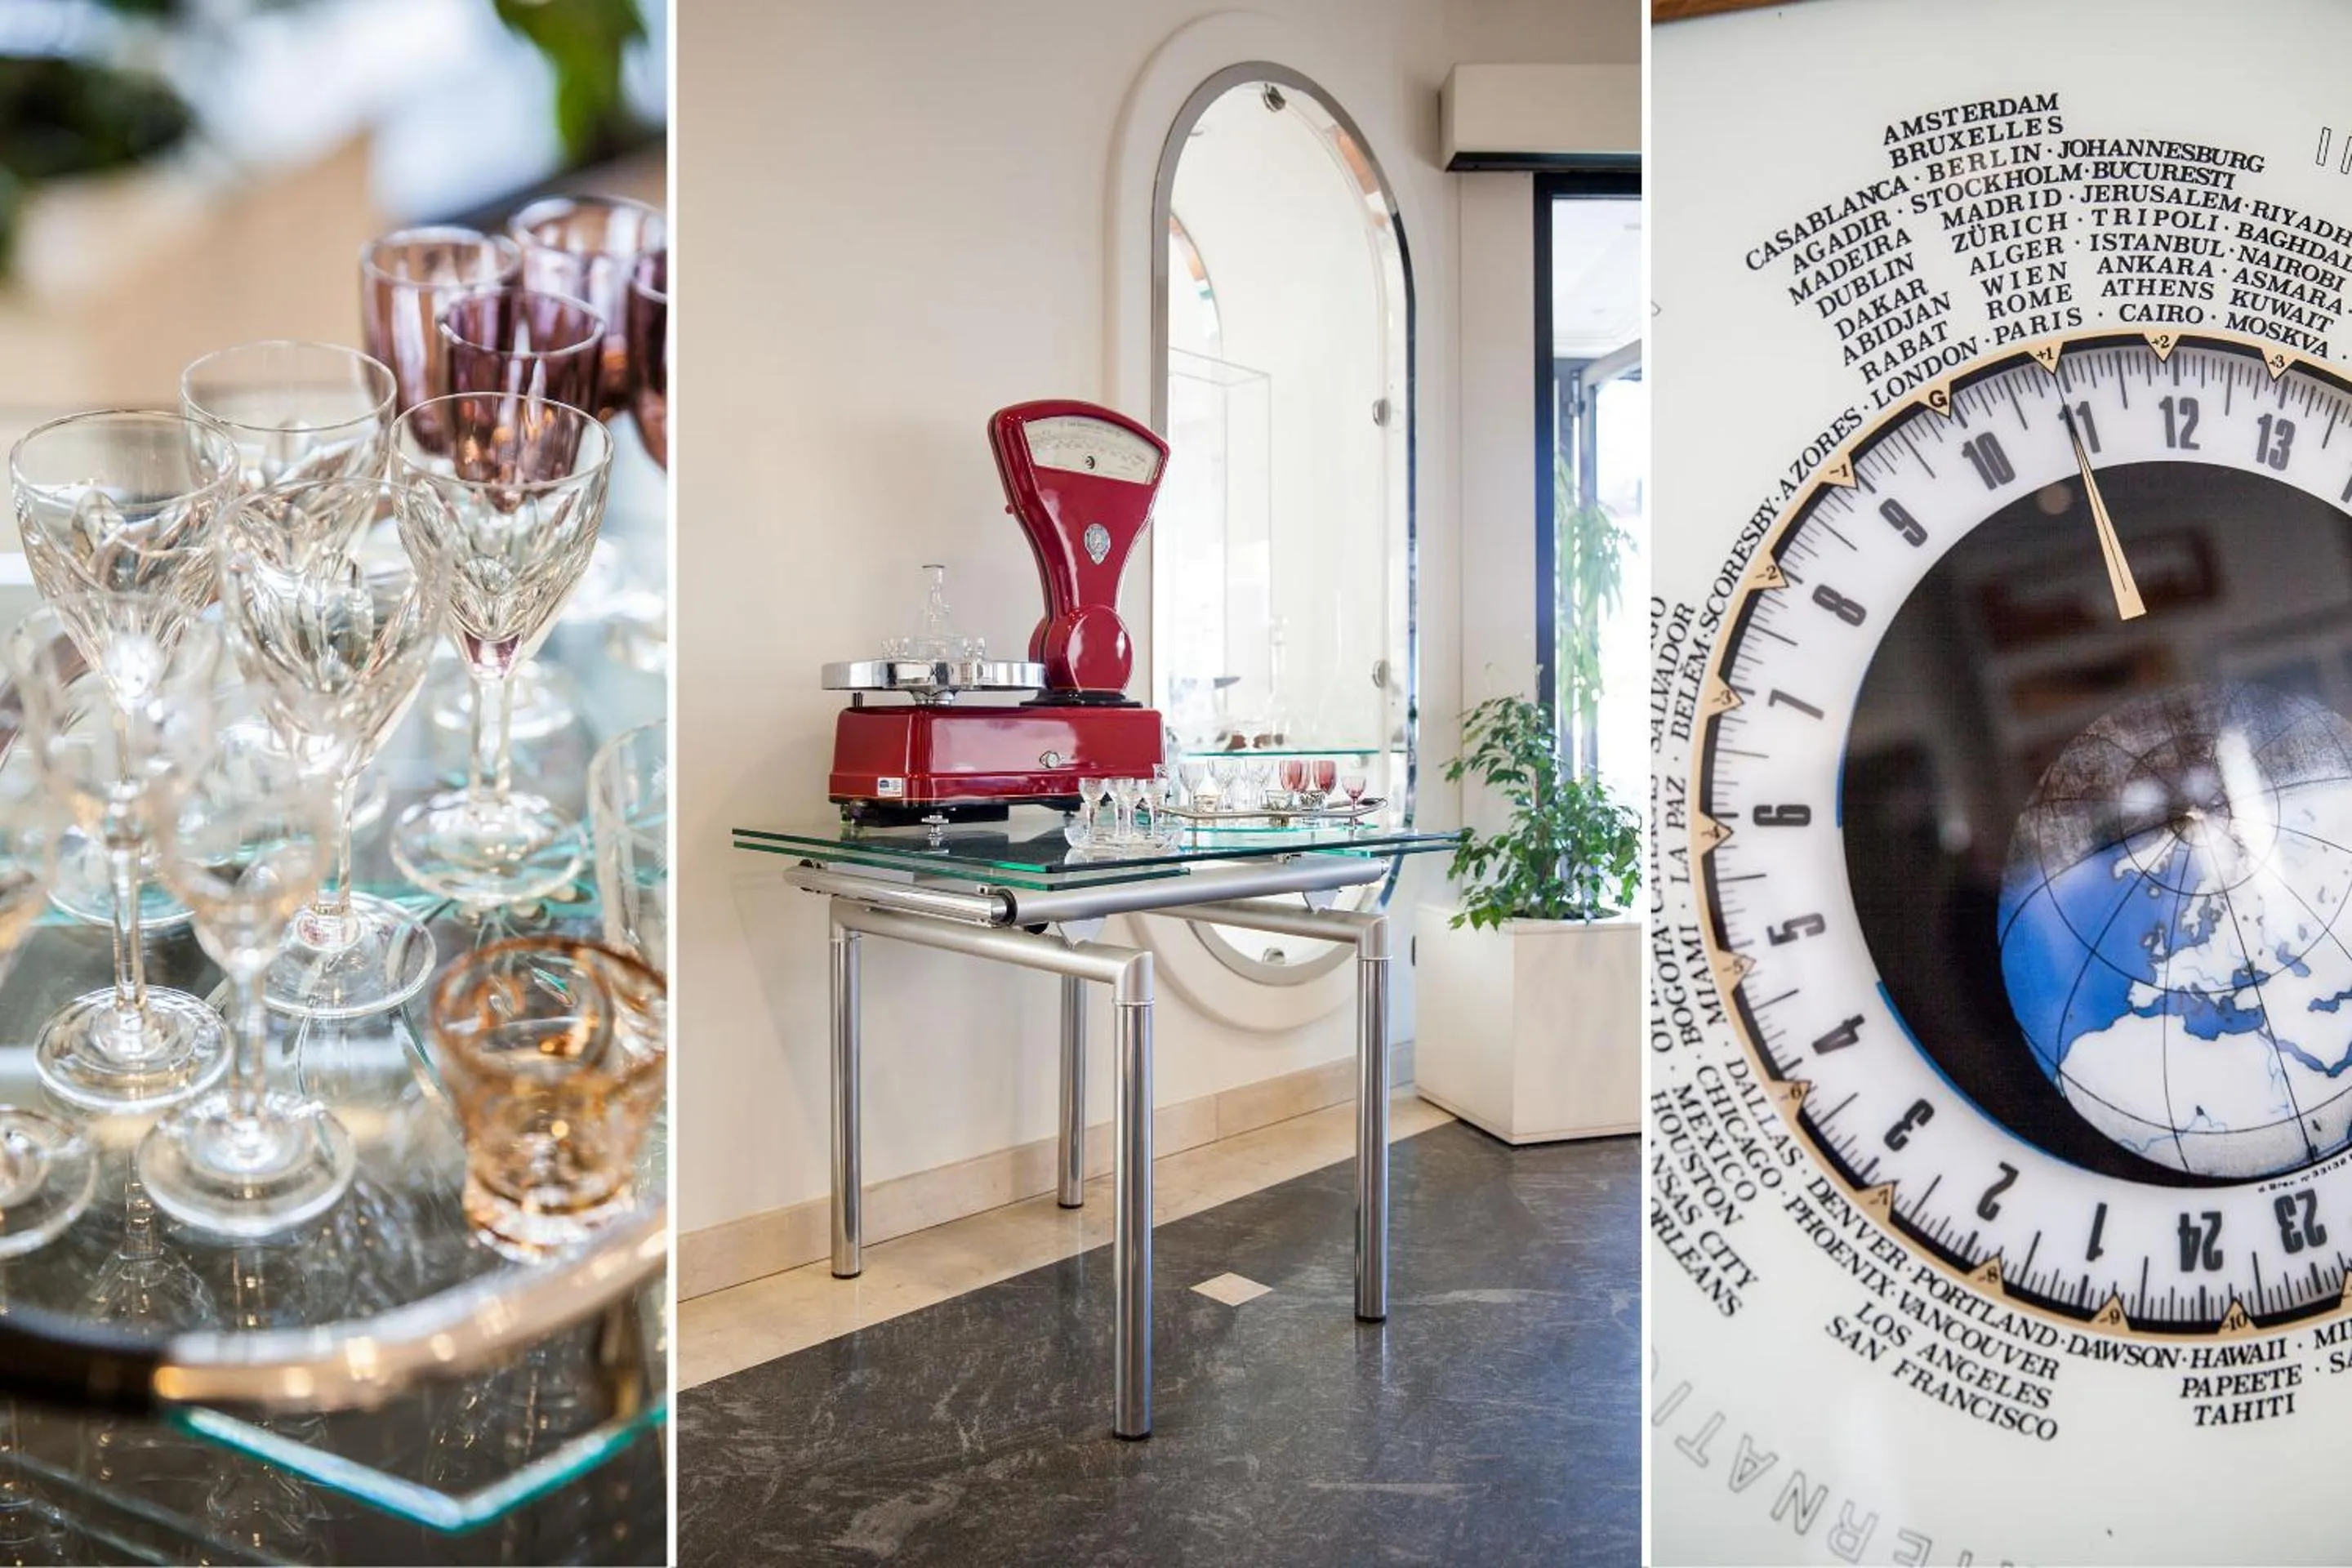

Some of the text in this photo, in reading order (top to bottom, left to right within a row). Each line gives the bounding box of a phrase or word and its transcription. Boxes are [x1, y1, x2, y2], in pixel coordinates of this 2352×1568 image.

[1883, 92, 2059, 145] AMSTERDAM
[1889, 116, 2064, 168] BRUXELLES
[1745, 139, 2265, 270] CASABLANCA BERLIN JOHANNESBURG
[1793, 162, 2236, 274] AGADIR STOCKHOLM BUCURESTI
[1788, 185, 2352, 305] MADEIRA MADRID JERUSALEM RIYADH
[1815, 252, 1915, 318] DUBLIN
[1953, 212, 2068, 253] ZÜRICH
[2091, 209, 2219, 231] TRIPOLI
[1835, 234, 2345, 340] DAKAR ALGER ISTANBUL NAIROBI
[1842, 255, 2341, 367] ABIDJAN WIEN ANKARA ASMARA
[1860, 278, 2334, 385] RABAT ROME ATHENS KUWAIT
[2037, 347, 2056, 360] +1
[2152, 336, 2169, 349] +2
[1928, 390, 1948, 408] G
[2158, 395, 2200, 451] 12
[1699, 497, 1780, 634] SCORESBY
[1779, 407, 1862, 501] AZORES
[1871, 337, 1978, 410] LONDON
[1996, 308, 2082, 345] PARIS
[2119, 304, 2203, 323] CAIRO
[2225, 313, 2330, 359] MOSKVA
[1961, 431, 2016, 491] 10
[2256, 412, 2296, 471] 13
[1878, 497, 1928, 548] 9
[1812, 583, 1866, 627] 8
[1768, 688, 1825, 720] 7
[1666, 775, 1690, 884] LA PAZ
[1753, 804, 1811, 826] 6
[1766, 912, 1826, 947] 5
[1652, 925, 1704, 1047] BOGOTA
[1678, 924, 1726, 1027] MIAMI
[1811, 1013, 1865, 1056] 4
[1883, 1098, 1935, 1152] 3
[1651, 1140, 1758, 1290] NSAS CITY
[1725, 1057, 1805, 1168] DALLAS
[1806, 1176, 1909, 1272] DENVER
[1911, 1265, 2059, 1348] PORTLAND
[2067, 1334, 2181, 1369] DAWSON
[2189, 1339, 2288, 1370] HAWAII
[1976, 1161, 2019, 1222] 2
[2274, 1188, 2328, 1254] 23
[1673, 1083, 2296, 1427] MEXICO LOS ANGELES TAHITI
[1695, 1064, 1784, 1189] CHICAGO
[1784, 1196, 1894, 1299] PHOENIX
[1897, 1290, 2060, 1381] VANCOUVER
[2179, 1365, 2303, 1399] PAPEETE
[2086, 1202, 2108, 1262] 1
[2177, 1211, 2224, 1272] 24
[1651, 1090, 2058, 1441] HOUSTON SAN FRANCISCO
